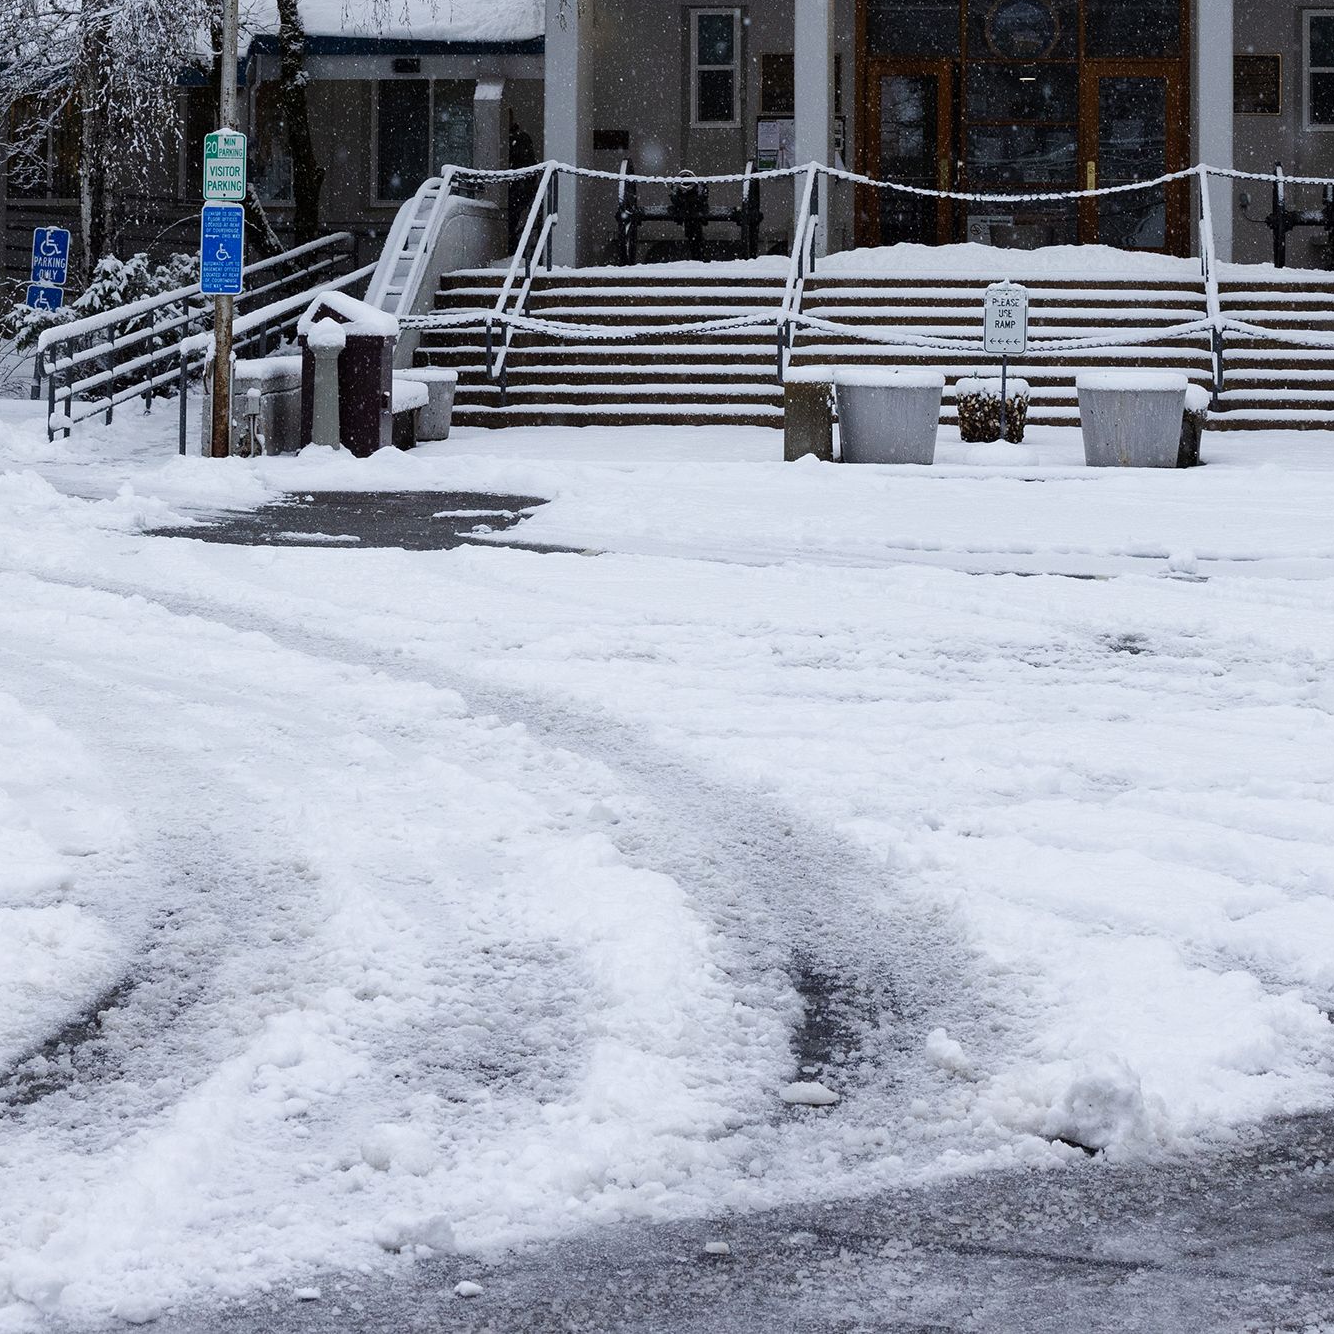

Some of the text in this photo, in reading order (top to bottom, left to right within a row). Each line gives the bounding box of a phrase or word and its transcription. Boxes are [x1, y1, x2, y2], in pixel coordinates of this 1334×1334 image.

[223, 137, 236, 146] MIN
[206, 141, 217, 154] 20
[218, 148, 243, 157] PARKING
[210, 166, 241, 177] VISITOR
[207, 180, 242, 192] PARKING
[33, 256, 66, 269] PARKING
[992, 297, 1020, 307] PLEASE
[998, 309, 1013, 318] USE
[994, 320, 1016, 329] RAMP
